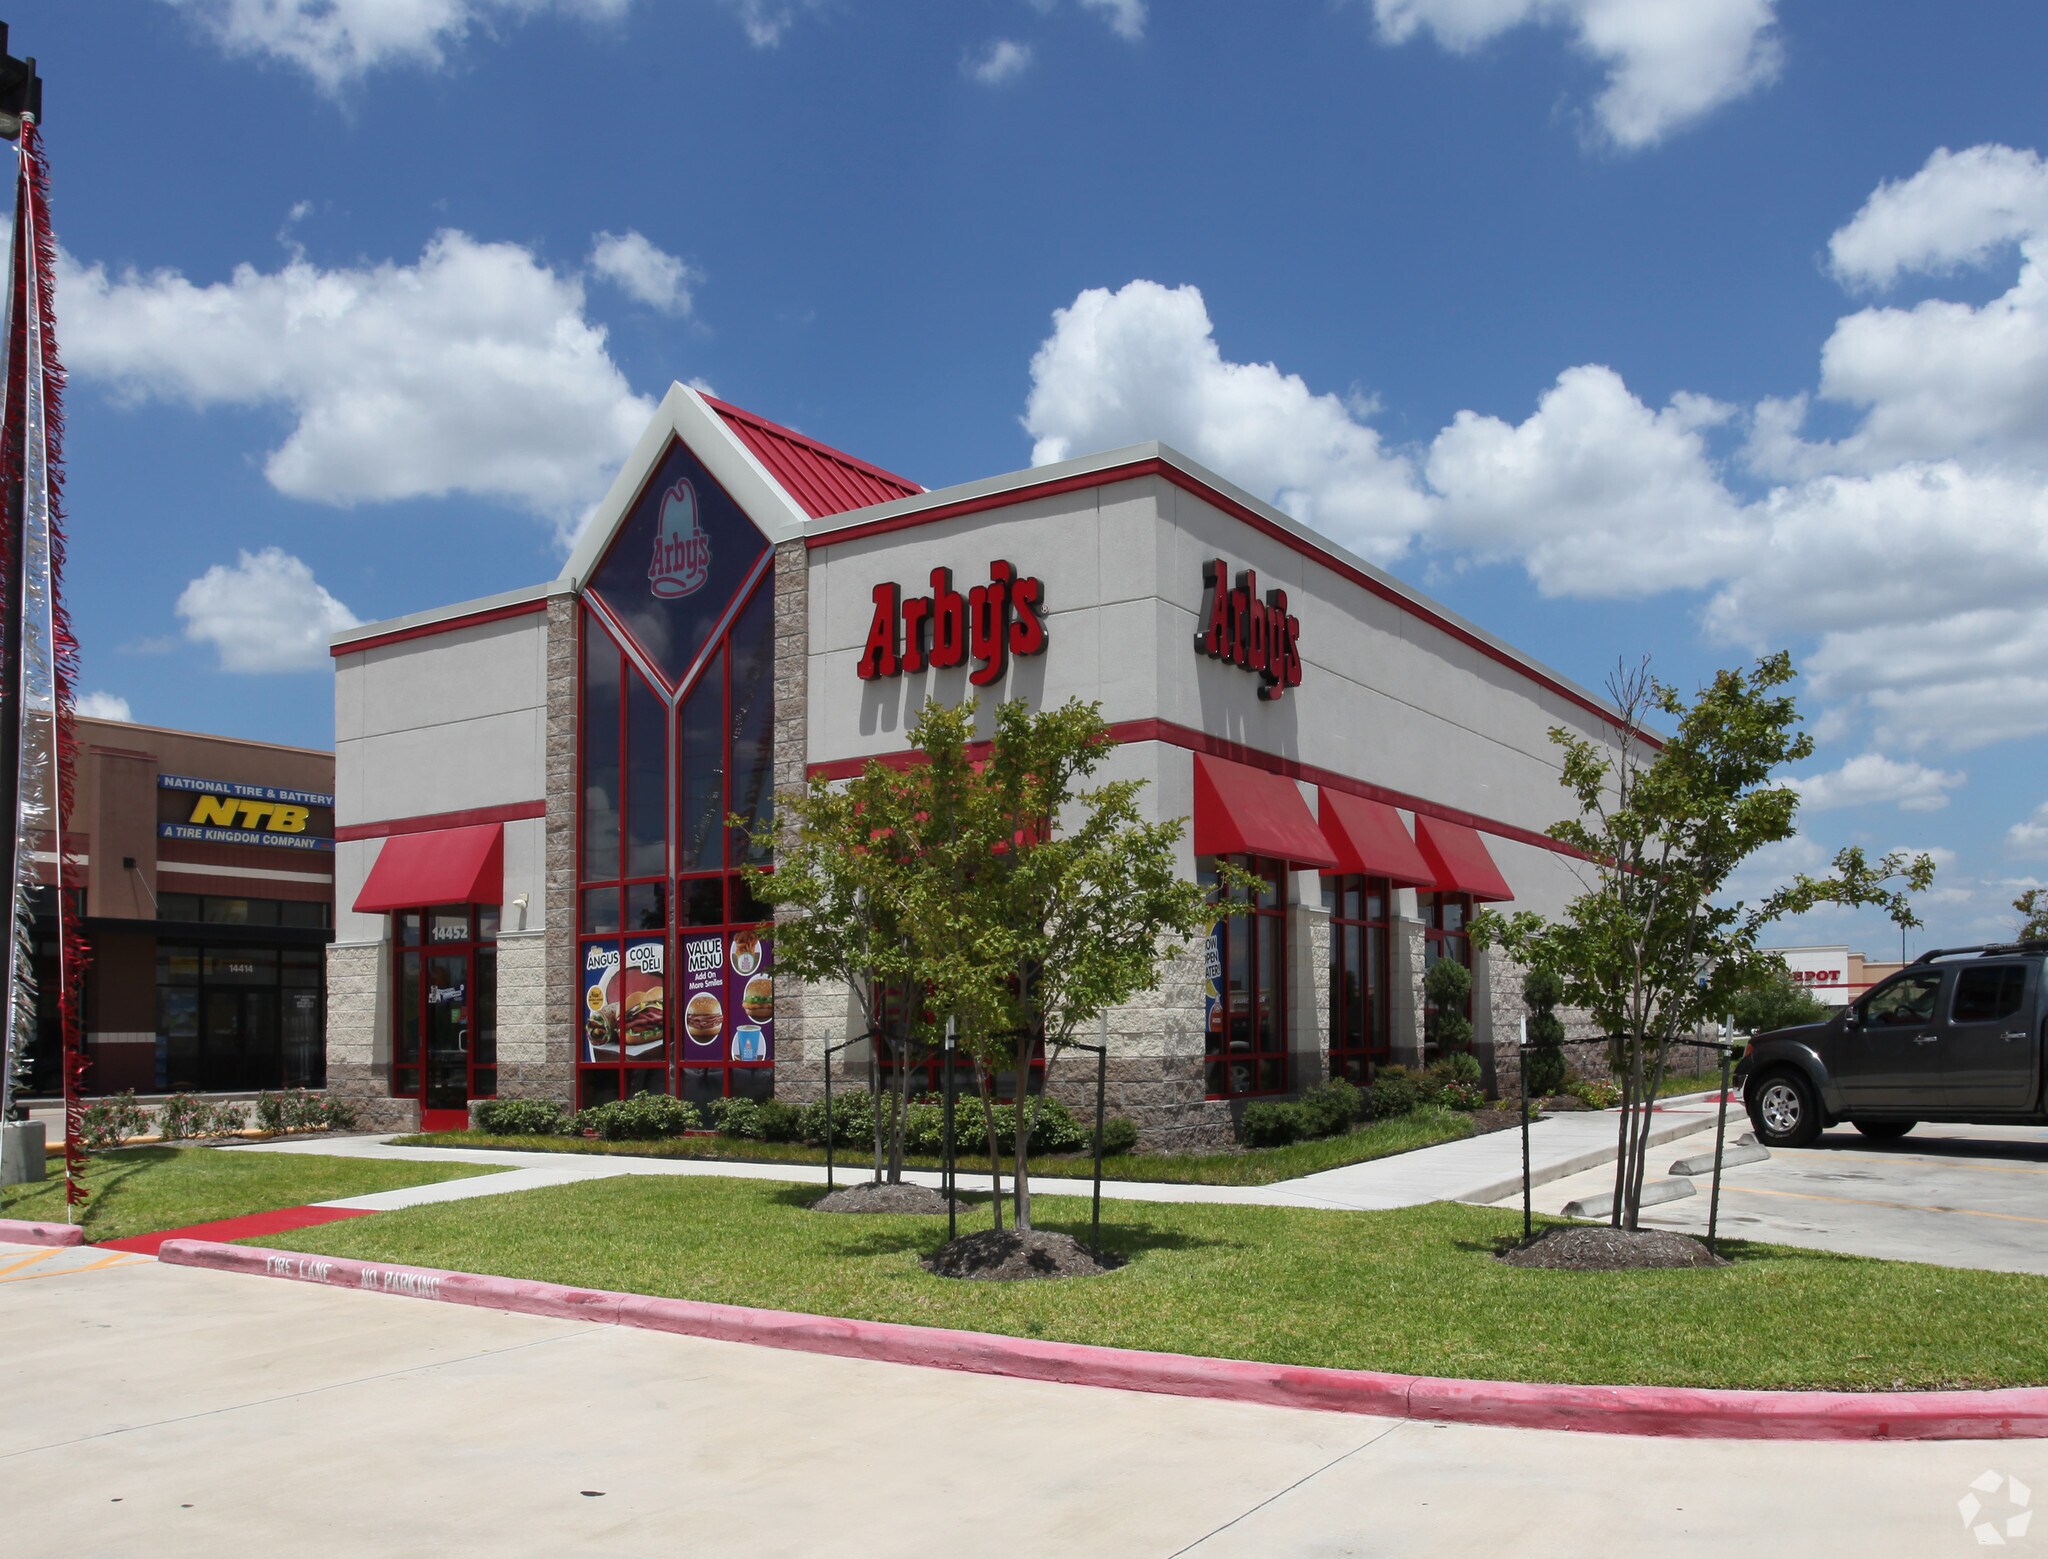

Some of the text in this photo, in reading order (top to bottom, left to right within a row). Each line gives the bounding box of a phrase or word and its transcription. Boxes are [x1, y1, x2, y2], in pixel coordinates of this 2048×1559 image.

[648, 528, 710, 580] Arby's
[857, 559, 1049, 687] Arby's
[1193, 557, 1302, 701] Arby's
[164, 776, 334, 805] NATIONAL TIRE & BATTERY
[189, 795, 310, 833] NTB
[164, 826, 173, 836] A
[176, 827, 202, 839] TIRE
[205, 830, 259, 844] KINGDOM
[262, 835, 316, 849] COMPANY
[431, 924, 468, 941] 14452
[687, 939, 721, 956] VALUE
[1205, 938, 1217, 951] OW
[588, 952, 619, 969] ANGUS
[629, 946, 655, 961] COOL
[689, 953, 722, 970] MENU
[1205, 951, 1218, 965] PEN
[229, 964, 253, 973] 14414
[642, 957, 661, 971] DELI
[1205, 964, 1221, 978] ATER!
[689, 978, 723, 990] More Smiles
[695, 971, 716, 981] Add On
[1792, 970, 1840, 981] EPOT
[267, 1255, 440, 1299] FIRE LANE NO PARKING
